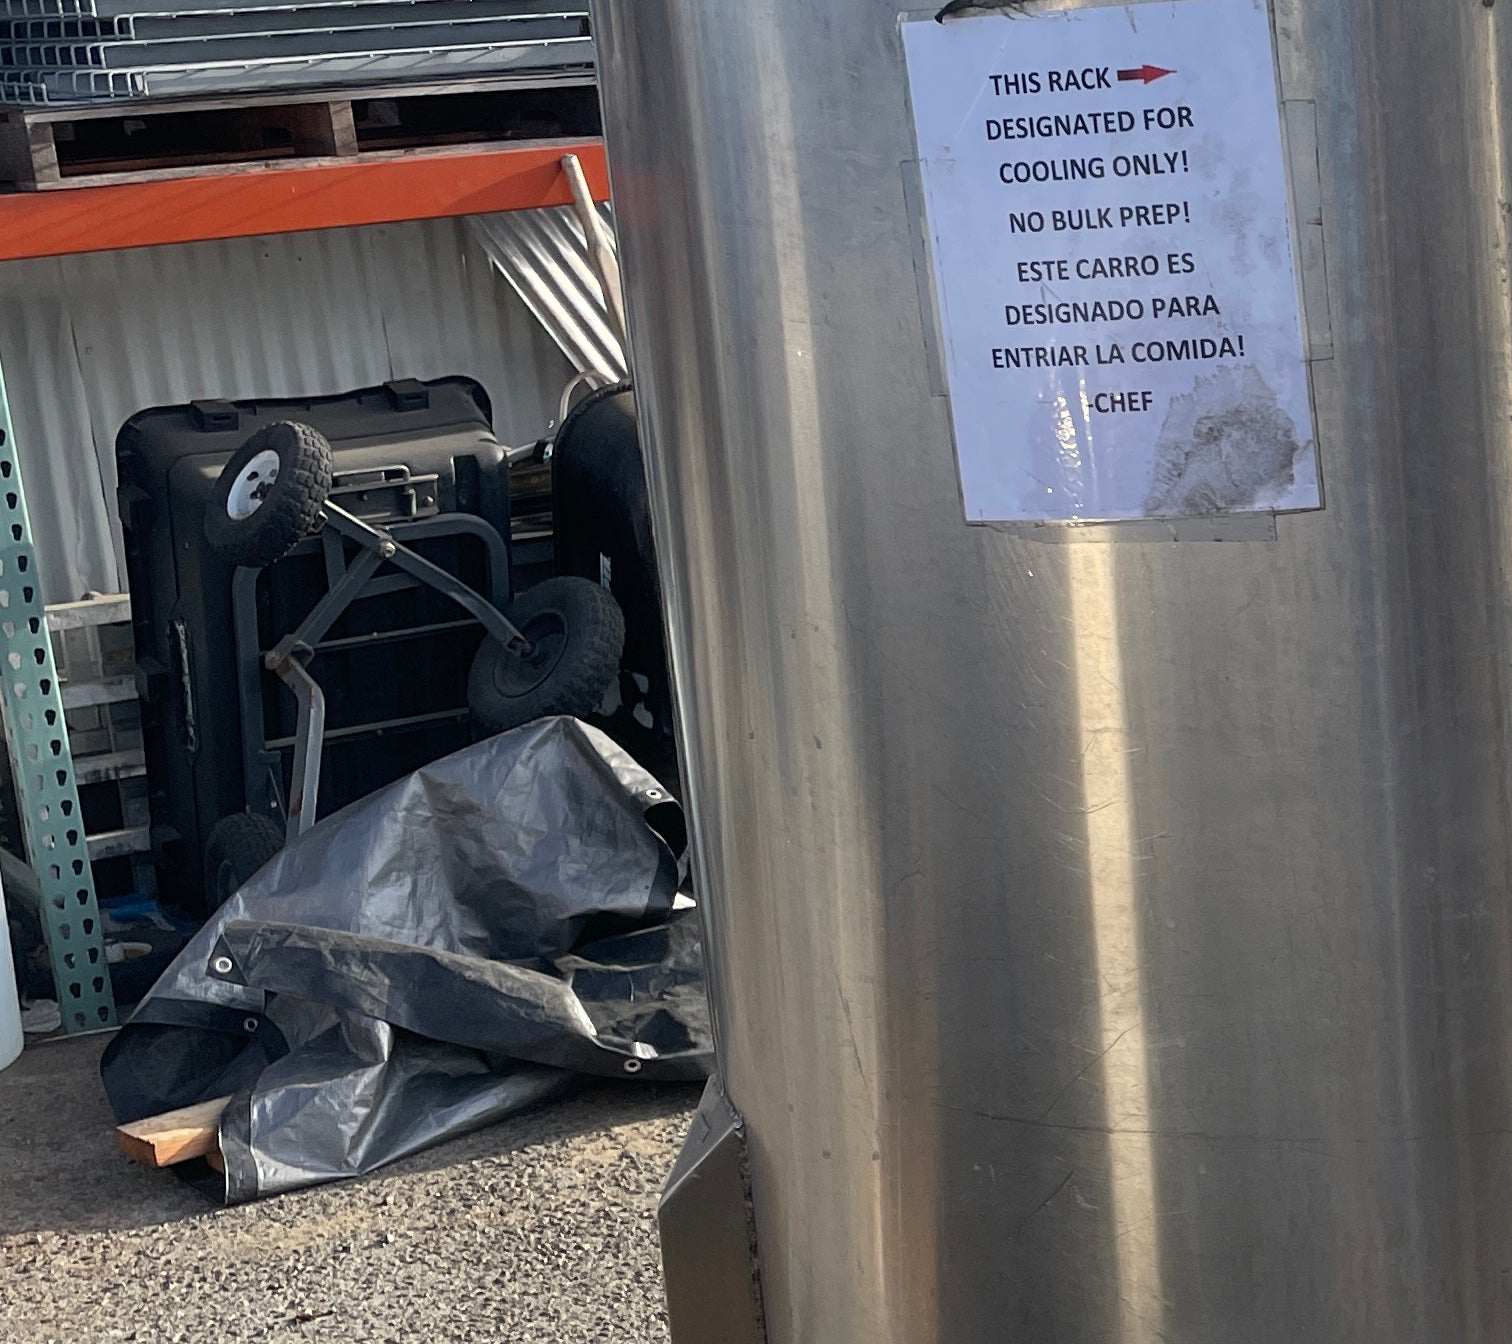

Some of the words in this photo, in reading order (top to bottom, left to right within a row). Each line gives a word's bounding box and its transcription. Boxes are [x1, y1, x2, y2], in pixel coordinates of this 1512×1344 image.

[989, 72, 1041, 95] THIS
[1048, 67, 1111, 92] RACK
[986, 111, 1134, 140] DESIGNATED
[1143, 107, 1193, 130] FOR
[1000, 158, 1104, 183] COOLING
[1113, 151, 1188, 176] ONLY!
[1010, 212, 1044, 233] NO
[1052, 208, 1112, 231] BULK
[1120, 202, 1189, 227] PREP!
[1018, 260, 1069, 282] ESTE
[1077, 255, 1158, 279] CARRO
[1168, 253, 1194, 274] ES
[1006, 300, 1143, 325] DESIGNADO
[1152, 295, 1220, 318] PARA
[992, 346, 1089, 368] ENTRIAR
[1096, 344, 1124, 364] LA
[1132, 335, 1244, 362] COMIDA!
[1088, 391, 1152, 413] -CHEF
